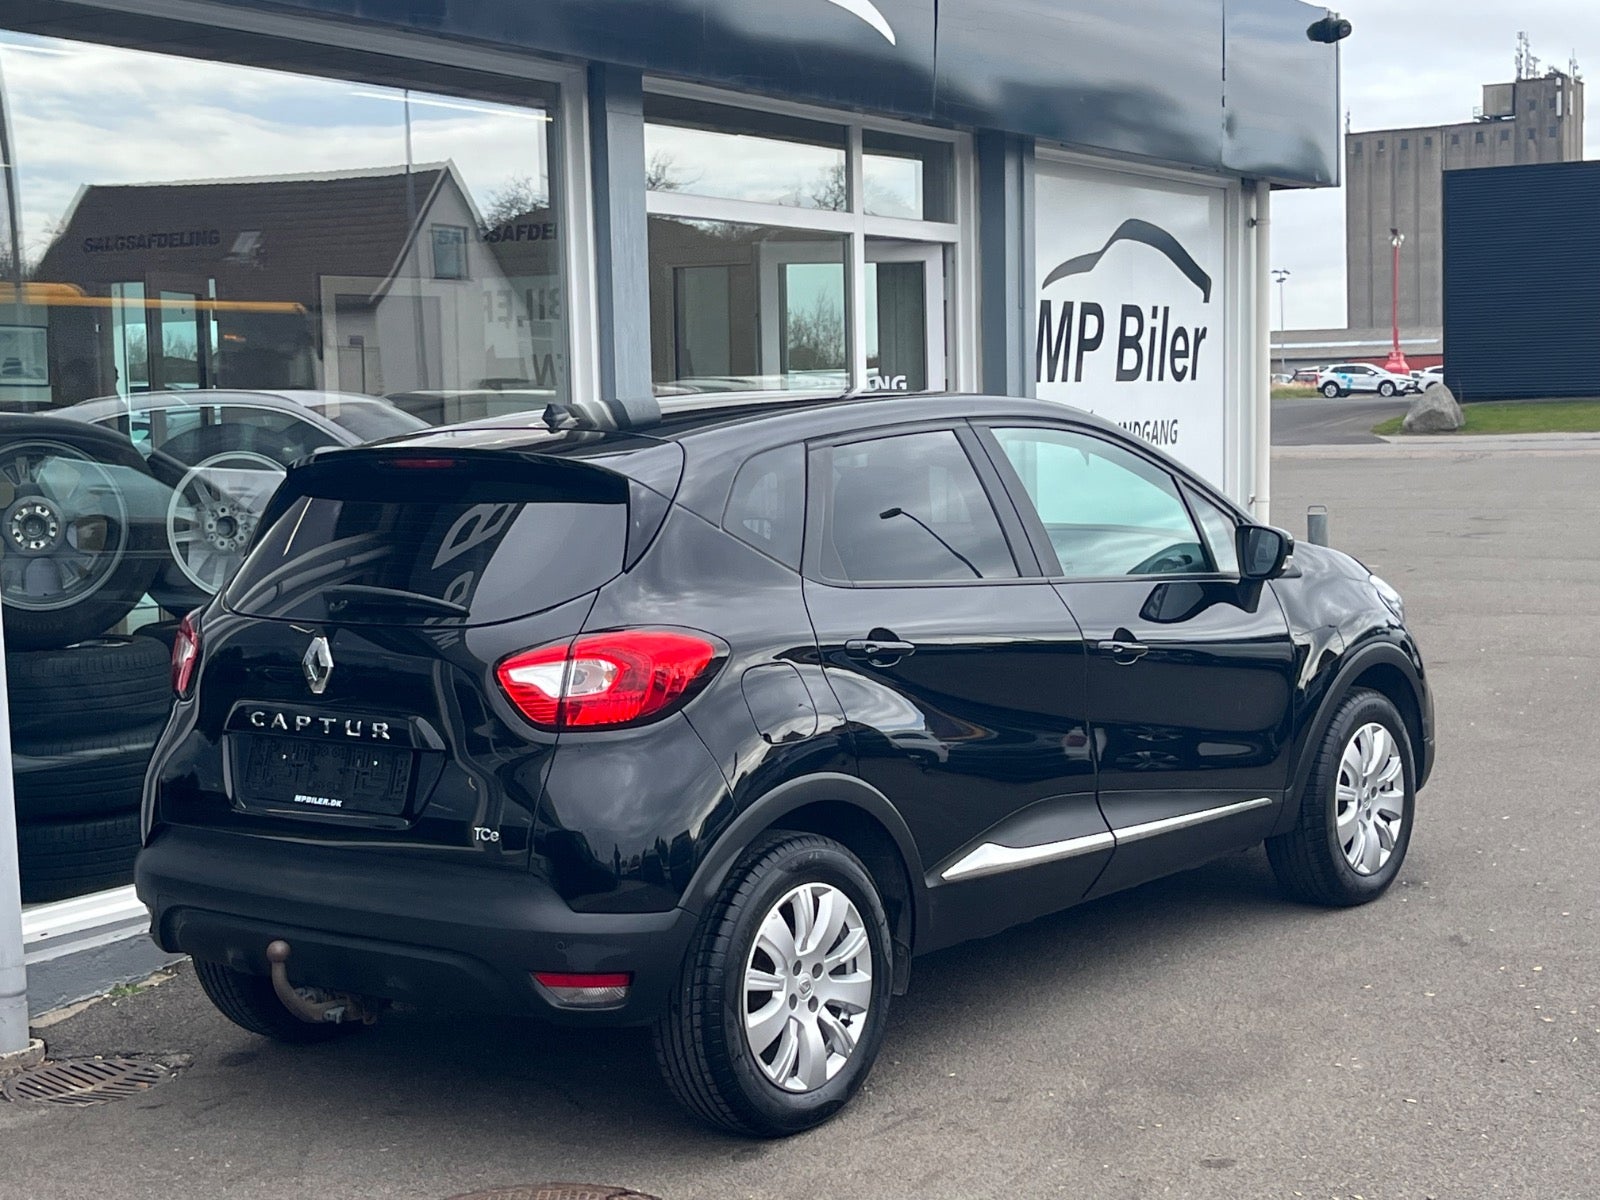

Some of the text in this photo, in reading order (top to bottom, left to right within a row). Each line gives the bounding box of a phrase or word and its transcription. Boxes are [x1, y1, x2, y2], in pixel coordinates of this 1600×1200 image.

[1036, 299, 1207, 383] MP Biler
[1118, 419, 1178, 445] DGANG
[250, 711, 390, 740] CAPTUR
[474, 827, 499, 842] TCe
